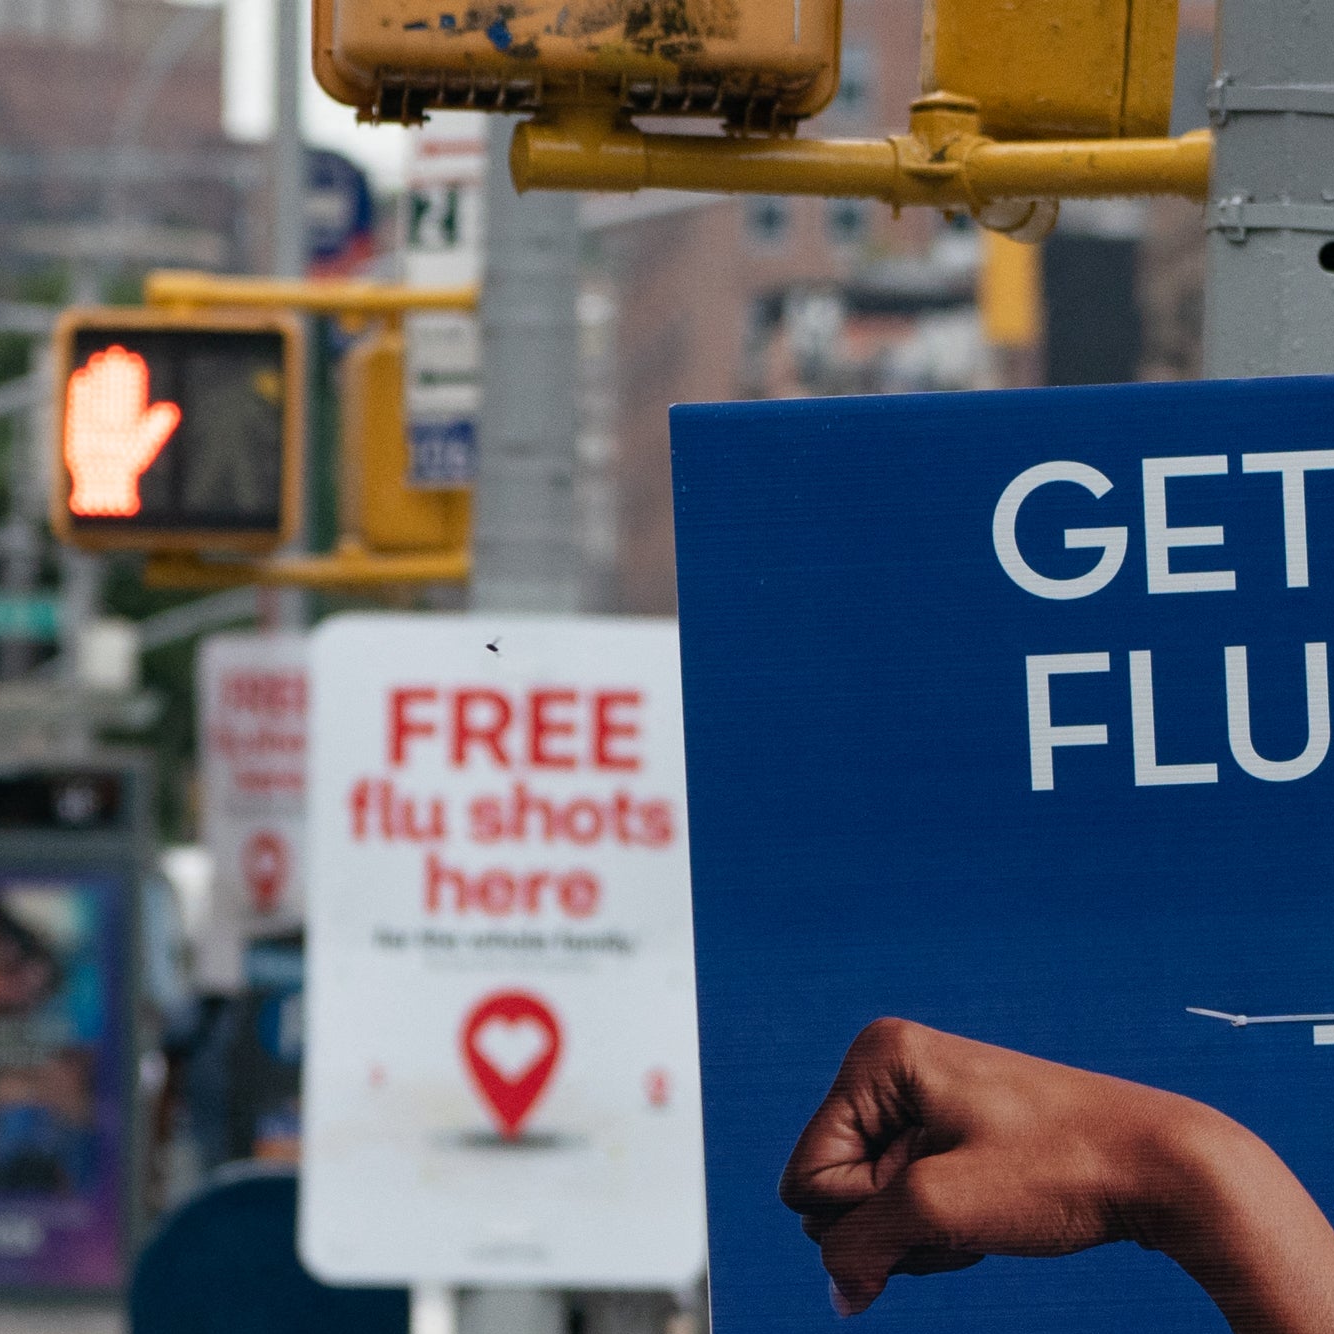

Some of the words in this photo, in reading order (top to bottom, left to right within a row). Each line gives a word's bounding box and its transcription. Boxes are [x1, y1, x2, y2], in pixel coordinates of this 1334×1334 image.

[386, 686, 645, 770] FREE
[1026, 643, 1330, 790] FLU
[349, 779, 445, 843] flu
[469, 781, 673, 848] shots
[424, 853, 602, 919] here
